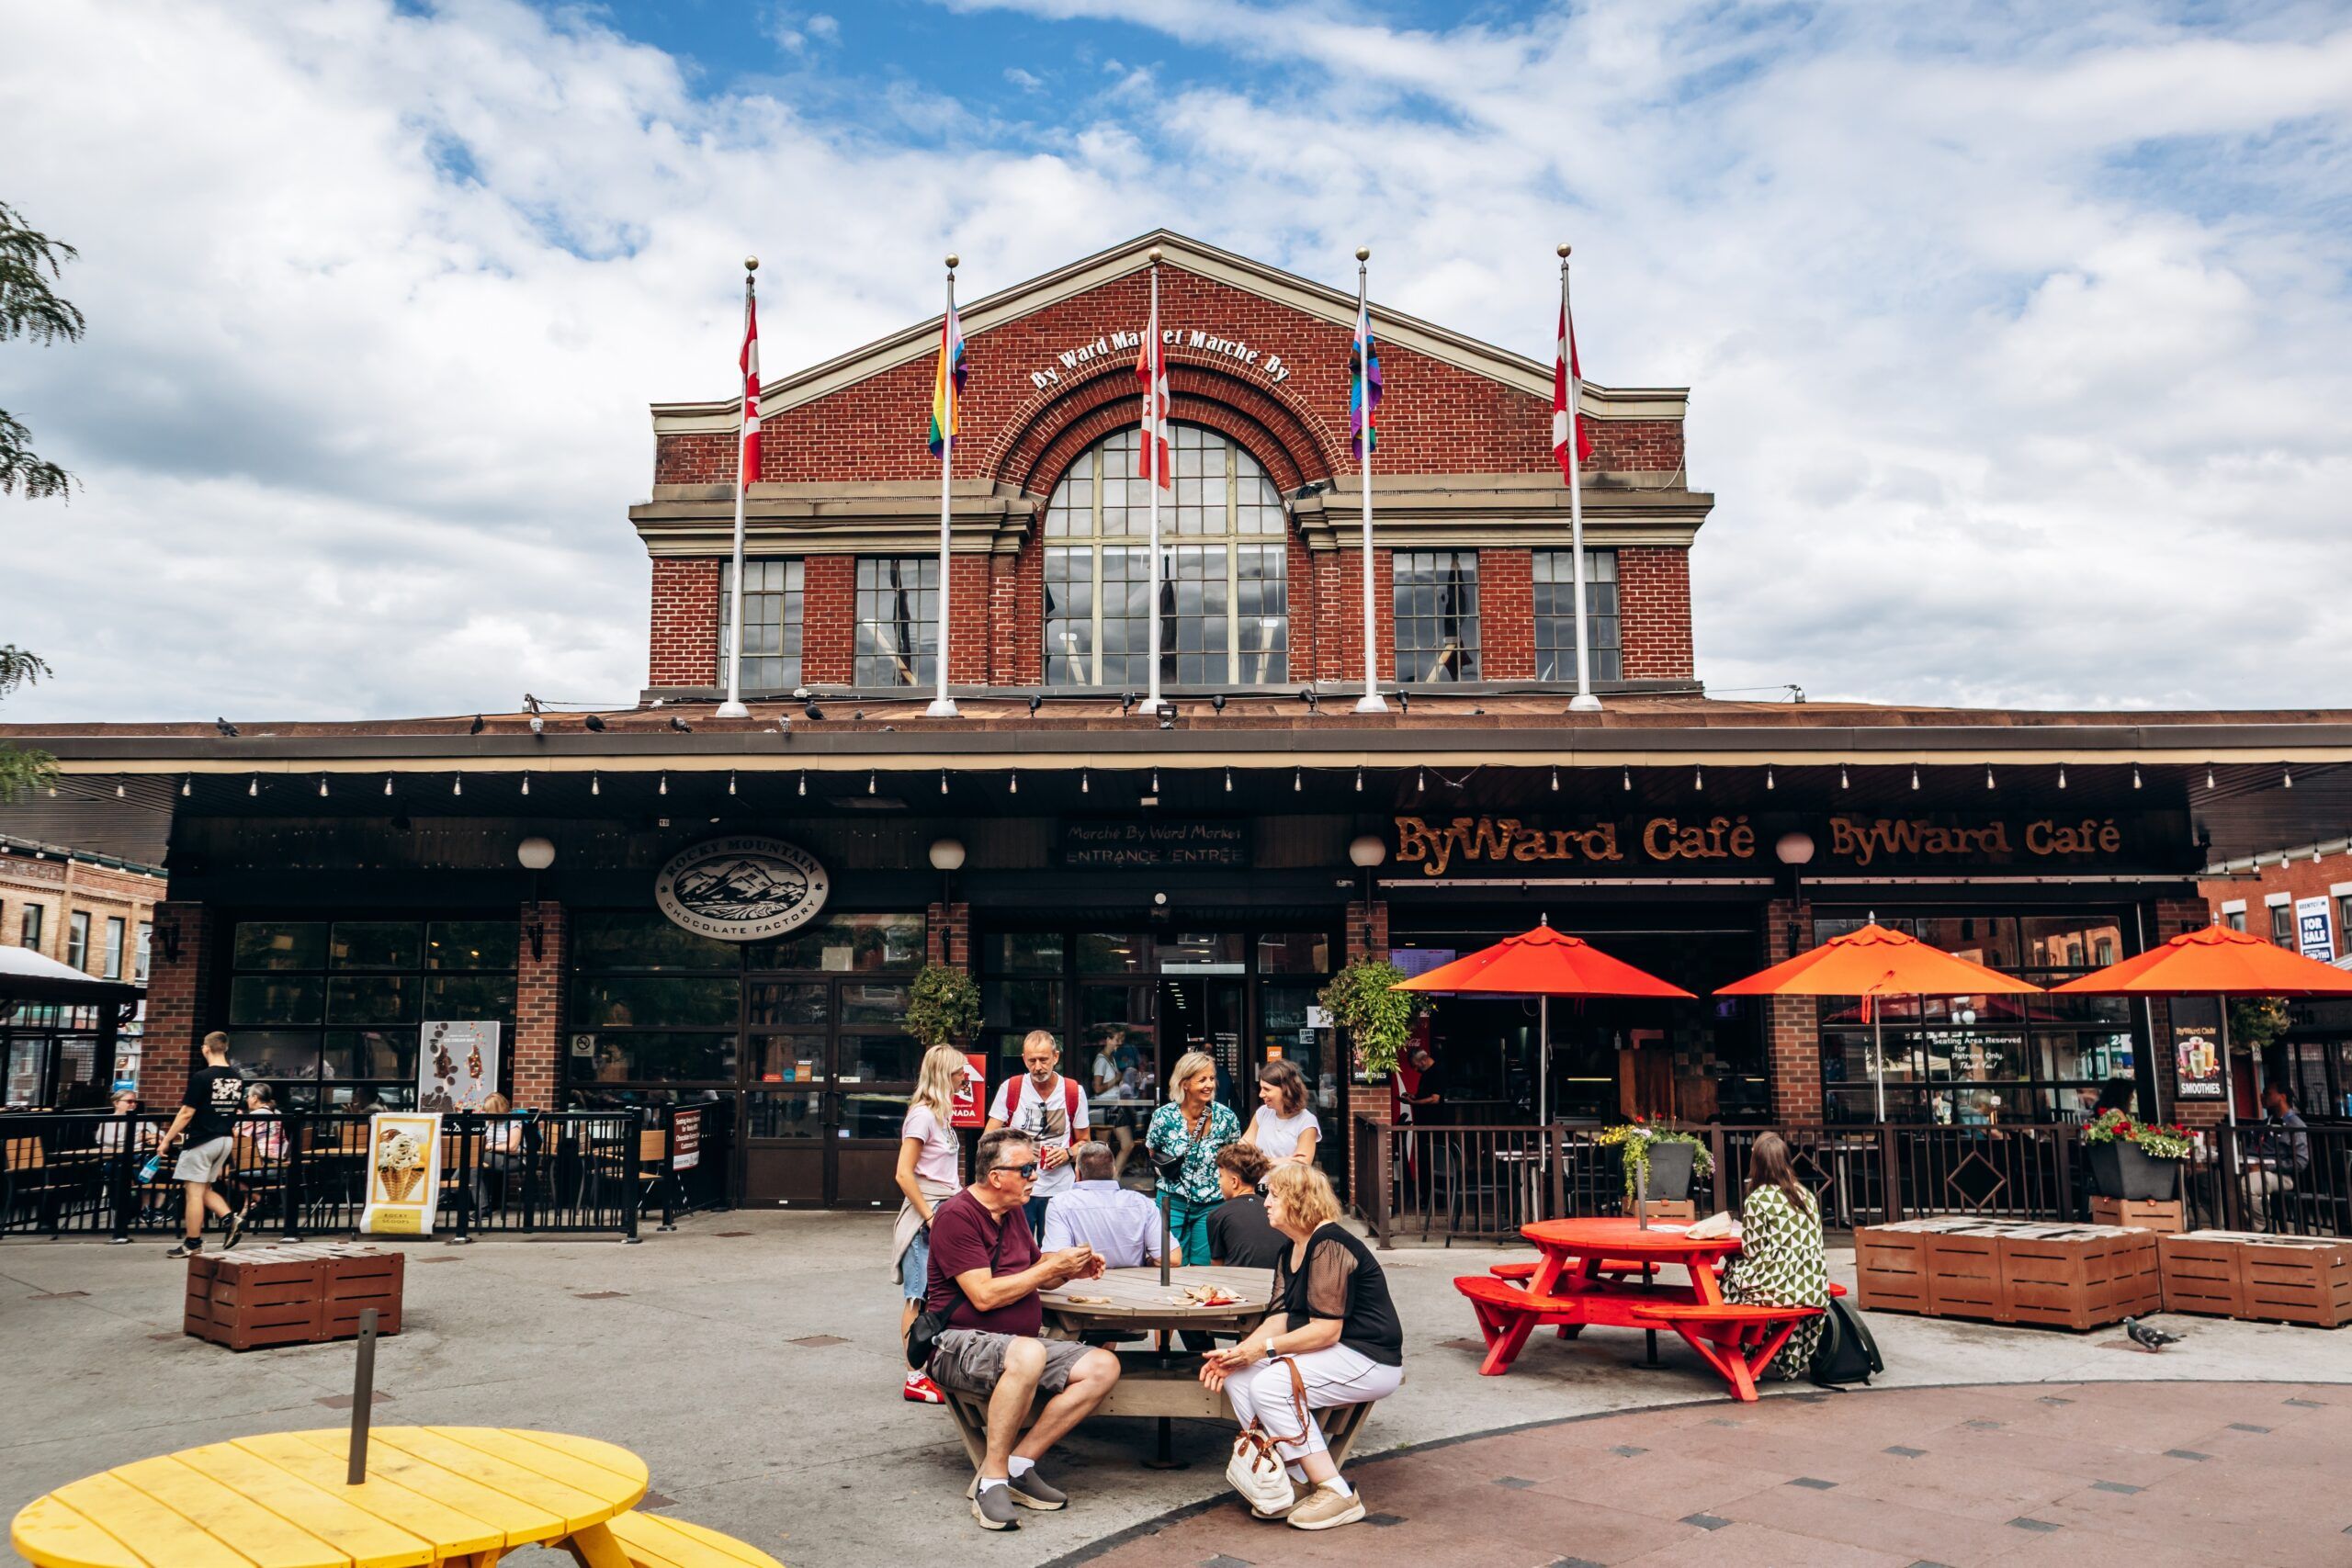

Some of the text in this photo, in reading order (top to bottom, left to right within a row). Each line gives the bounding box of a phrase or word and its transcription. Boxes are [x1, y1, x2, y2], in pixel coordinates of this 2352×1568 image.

[1029, 367, 1059, 389] By
[1058, 337, 1109, 369] Ward
[1110, 329, 1183, 351] Maret
[1262, 354, 1291, 383] By
[1126, 824, 1146, 842] By
[1149, 825, 1185, 840] Ward
[1394, 815, 1757, 875] ByWard Café
[1829, 817, 2120, 866] ByWard Café
[666, 840, 820, 877] ROCKY MOUNTAIN
[1067, 849, 1160, 863] ENTRANCE
[665, 898, 815, 934] CHOCOLATE FACTORY
[2303, 917, 2323, 931] FOR
[2303, 930, 2326, 944] SALE
[1932, 1037, 1962, 1045] Seating
[1959, 1061, 1997, 1069] Thank You!
[2181, 1083, 2221, 1095] SMOOTHIES
[951, 1109, 976, 1117] NADA
